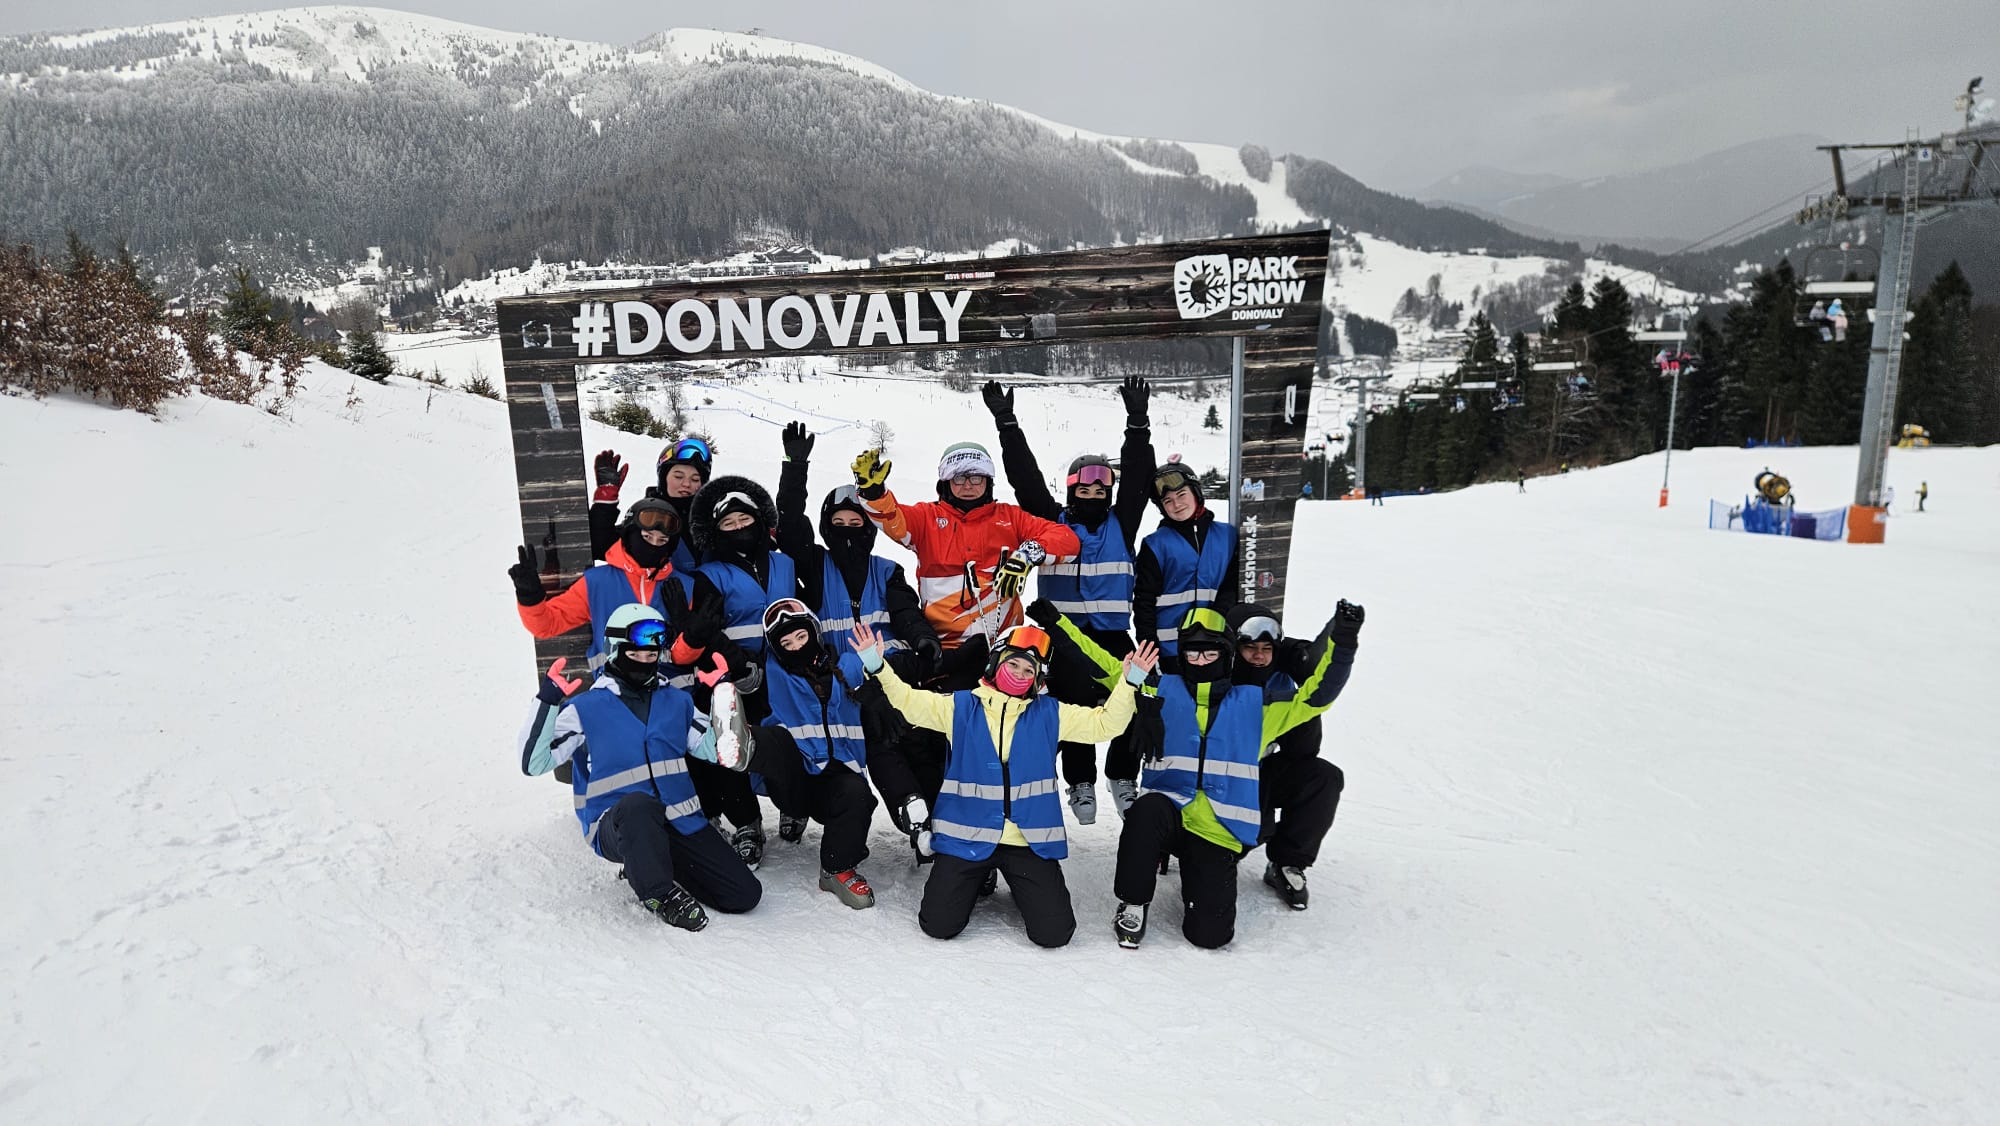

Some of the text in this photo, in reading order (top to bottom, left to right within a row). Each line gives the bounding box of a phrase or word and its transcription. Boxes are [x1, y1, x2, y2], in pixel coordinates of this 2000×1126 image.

[1232, 255, 1299, 281] PARK
[1231, 280, 1306, 306] SNOW
[572, 290, 972, 357] #DONOVALY
[1232, 308, 1284, 320] DONOVALY
[1241, 515, 1257, 604] arksnow.sk
